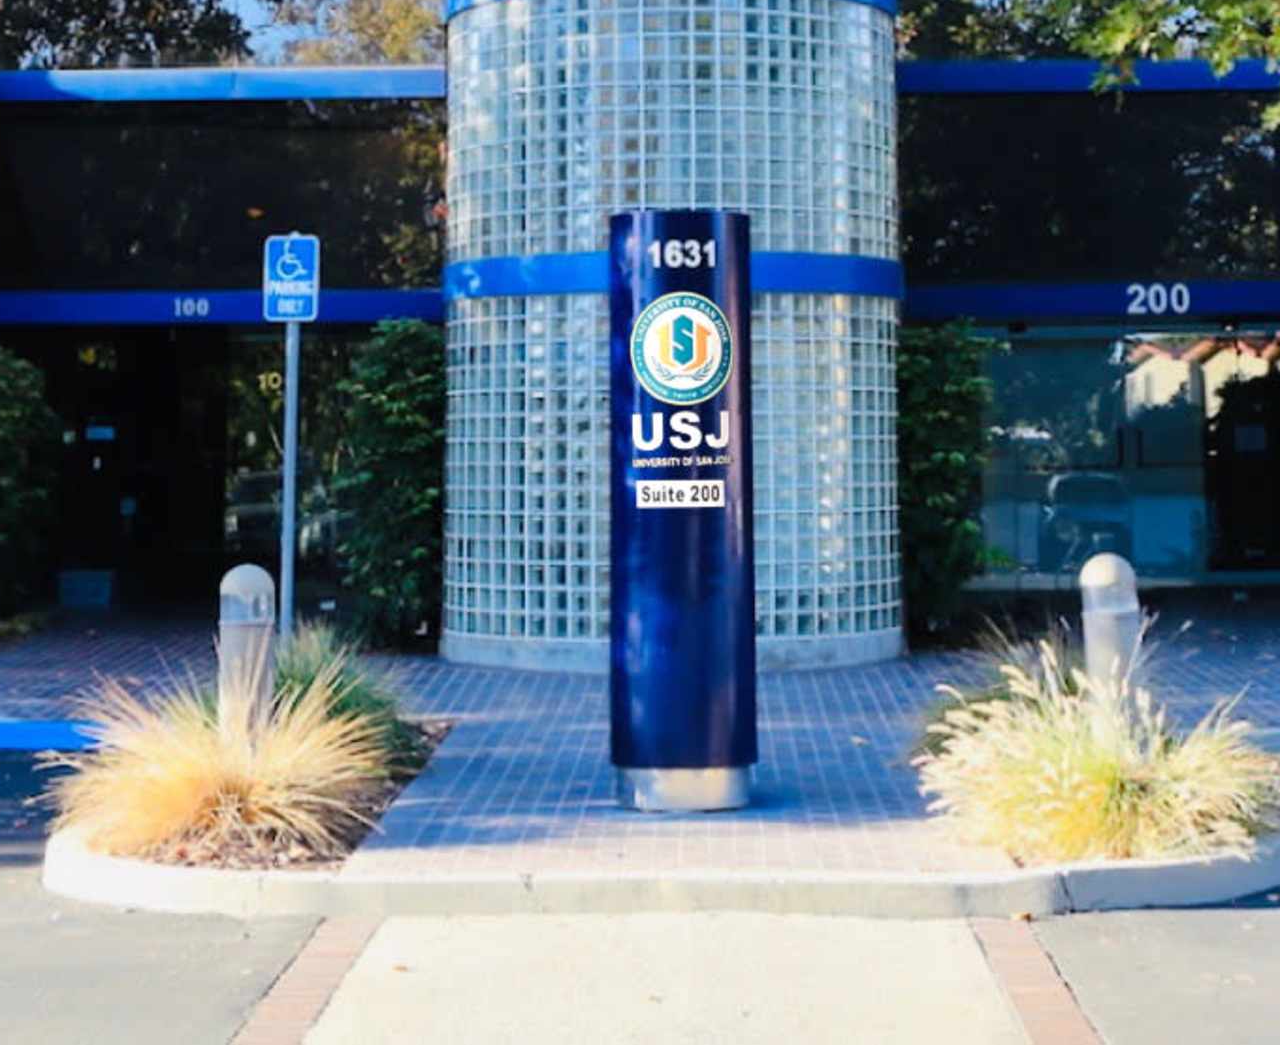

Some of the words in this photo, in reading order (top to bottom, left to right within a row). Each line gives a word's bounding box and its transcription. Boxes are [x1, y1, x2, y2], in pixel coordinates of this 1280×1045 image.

[647, 239, 716, 269] 1631
[174, 297, 209, 317] 100
[1126, 282, 1190, 314] 200
[632, 410, 730, 451] USJ
[632, 457, 680, 468] UNIVERSITY
[682, 456, 694, 466] OF
[695, 456, 713, 466] SAN
[641, 485, 685, 502] Suite
[689, 484, 721, 502] 200
